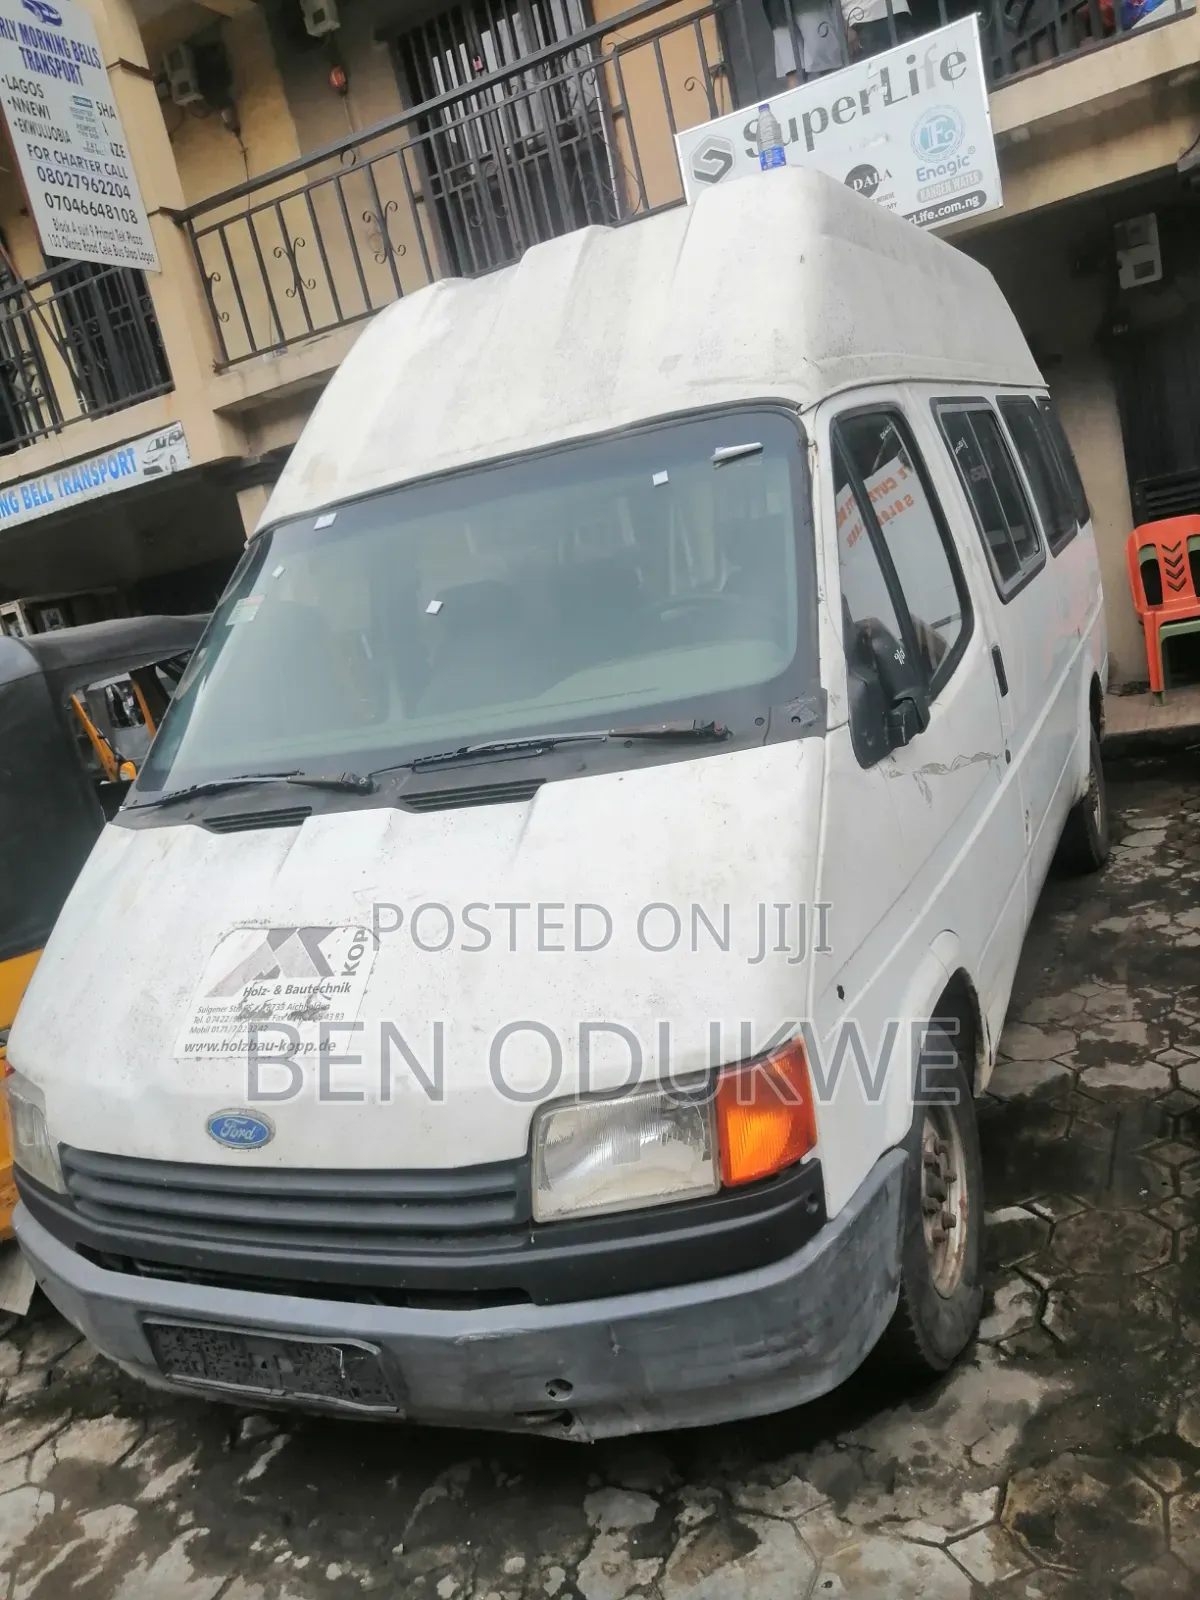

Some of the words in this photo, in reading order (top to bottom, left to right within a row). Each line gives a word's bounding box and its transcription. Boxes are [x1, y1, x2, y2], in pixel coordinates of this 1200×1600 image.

[18, 22, 72, 60] MORNING
[70, 39, 102, 70] BELLS
[18, 45, 84, 87] TRANSPORT
[5, 74, 44, 99] LAGOS
[743, 43, 967, 159] SuperLife
[11, 96, 51, 121] NNEWI
[27, 143, 52, 162] FOR
[53, 150, 102, 174] CHARTER
[104, 163, 129, 180] CALL
[916, 154, 971, 182] Enagic
[37, 166, 132, 200] 08027962204
[44, 192, 139, 225] 07046648108
[20, 479, 54, 510] BELL
[55, 447, 137, 498] TRANSPORT
[273, 984, 283, 996] &
[284, 982, 352, 996] Bautechnik
[184, 1038, 337, 1055] www.holzbau-kopp.de
[220, 1118, 257, 1141] Ford
